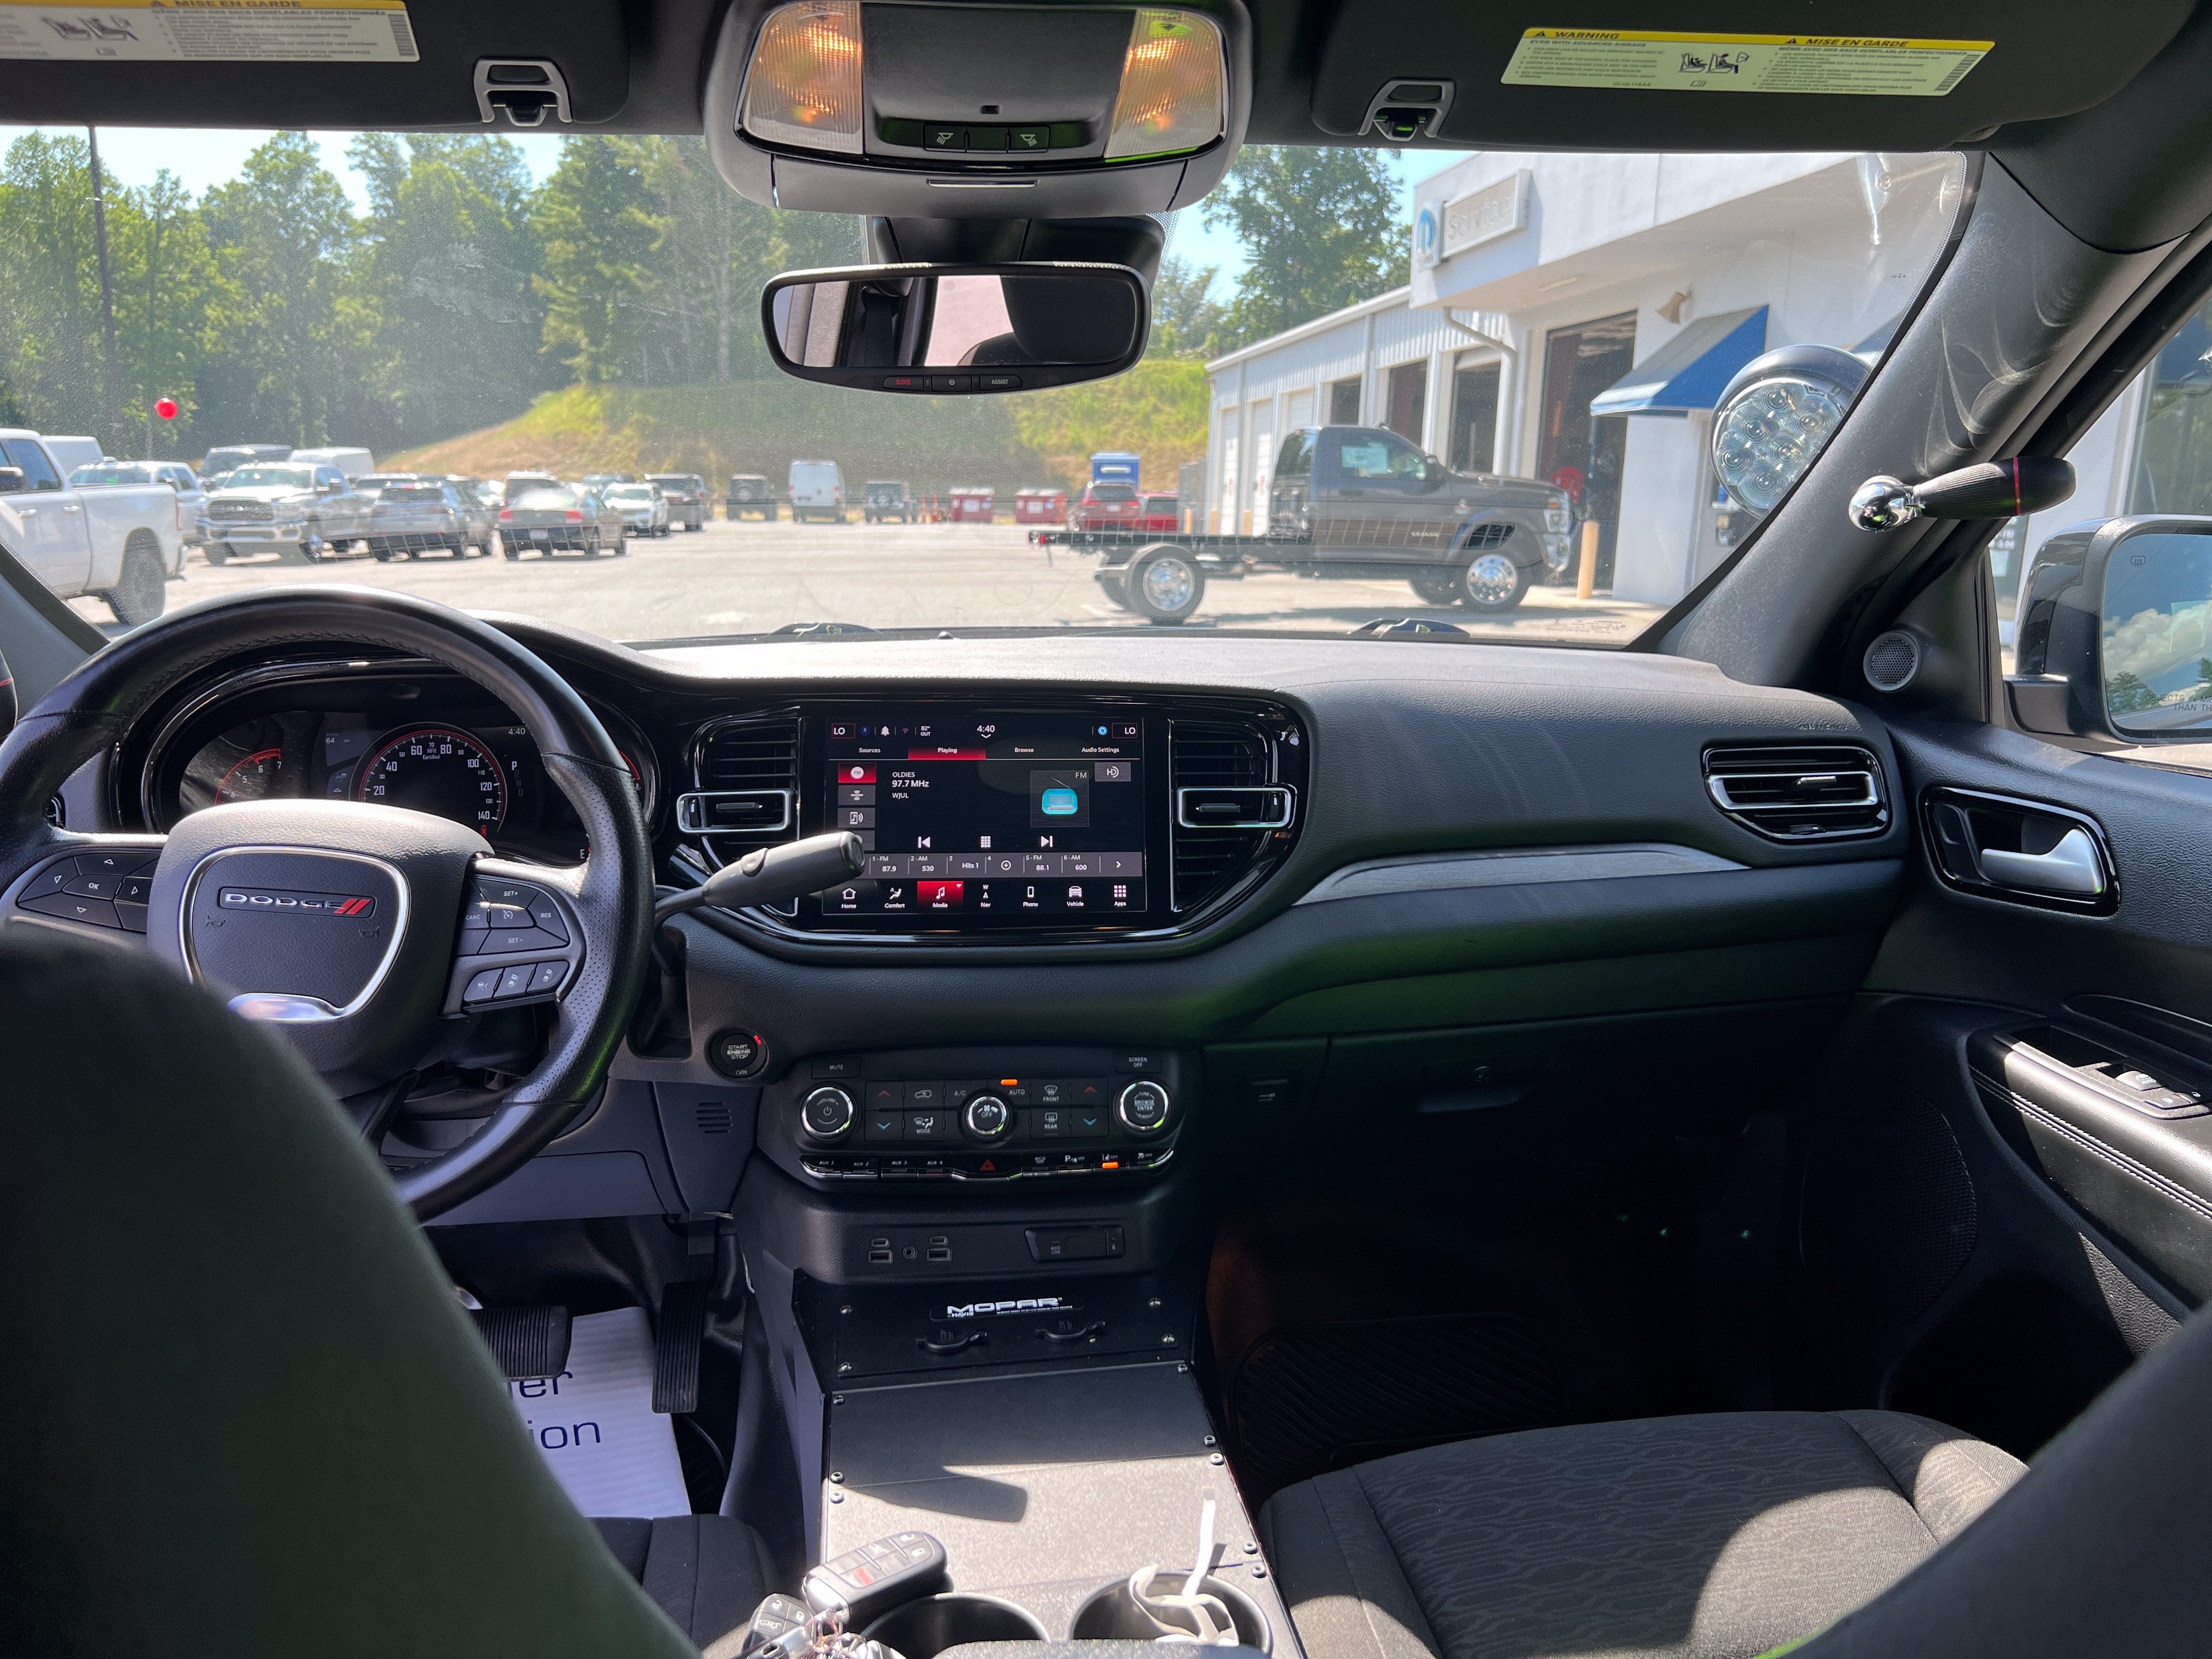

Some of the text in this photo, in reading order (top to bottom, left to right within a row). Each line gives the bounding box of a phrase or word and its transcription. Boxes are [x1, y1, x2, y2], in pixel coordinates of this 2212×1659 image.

[2145, 693, 2185, 702] OBJECTS
[2174, 703, 2196, 712] THAN
[833, 727, 845, 735] LO
[977, 725, 995, 733] 4:40
[411, 745, 422, 755] 60
[440, 744, 452, 754] 80
[277, 761, 282, 769] 7
[386, 761, 398, 772] 40
[467, 759, 479, 768] 100
[511, 761, 517, 771] P
[480, 782, 492, 792] 120
[891, 780, 910, 788] 97.7
[374, 785, 385, 796] 20
[478, 810, 490, 820] 140
[580, 849, 585, 859] E
[88, 882, 100, 890] OK
[225, 893, 346, 910] DODGE
[947, 1297, 1059, 1315] MOPAR
